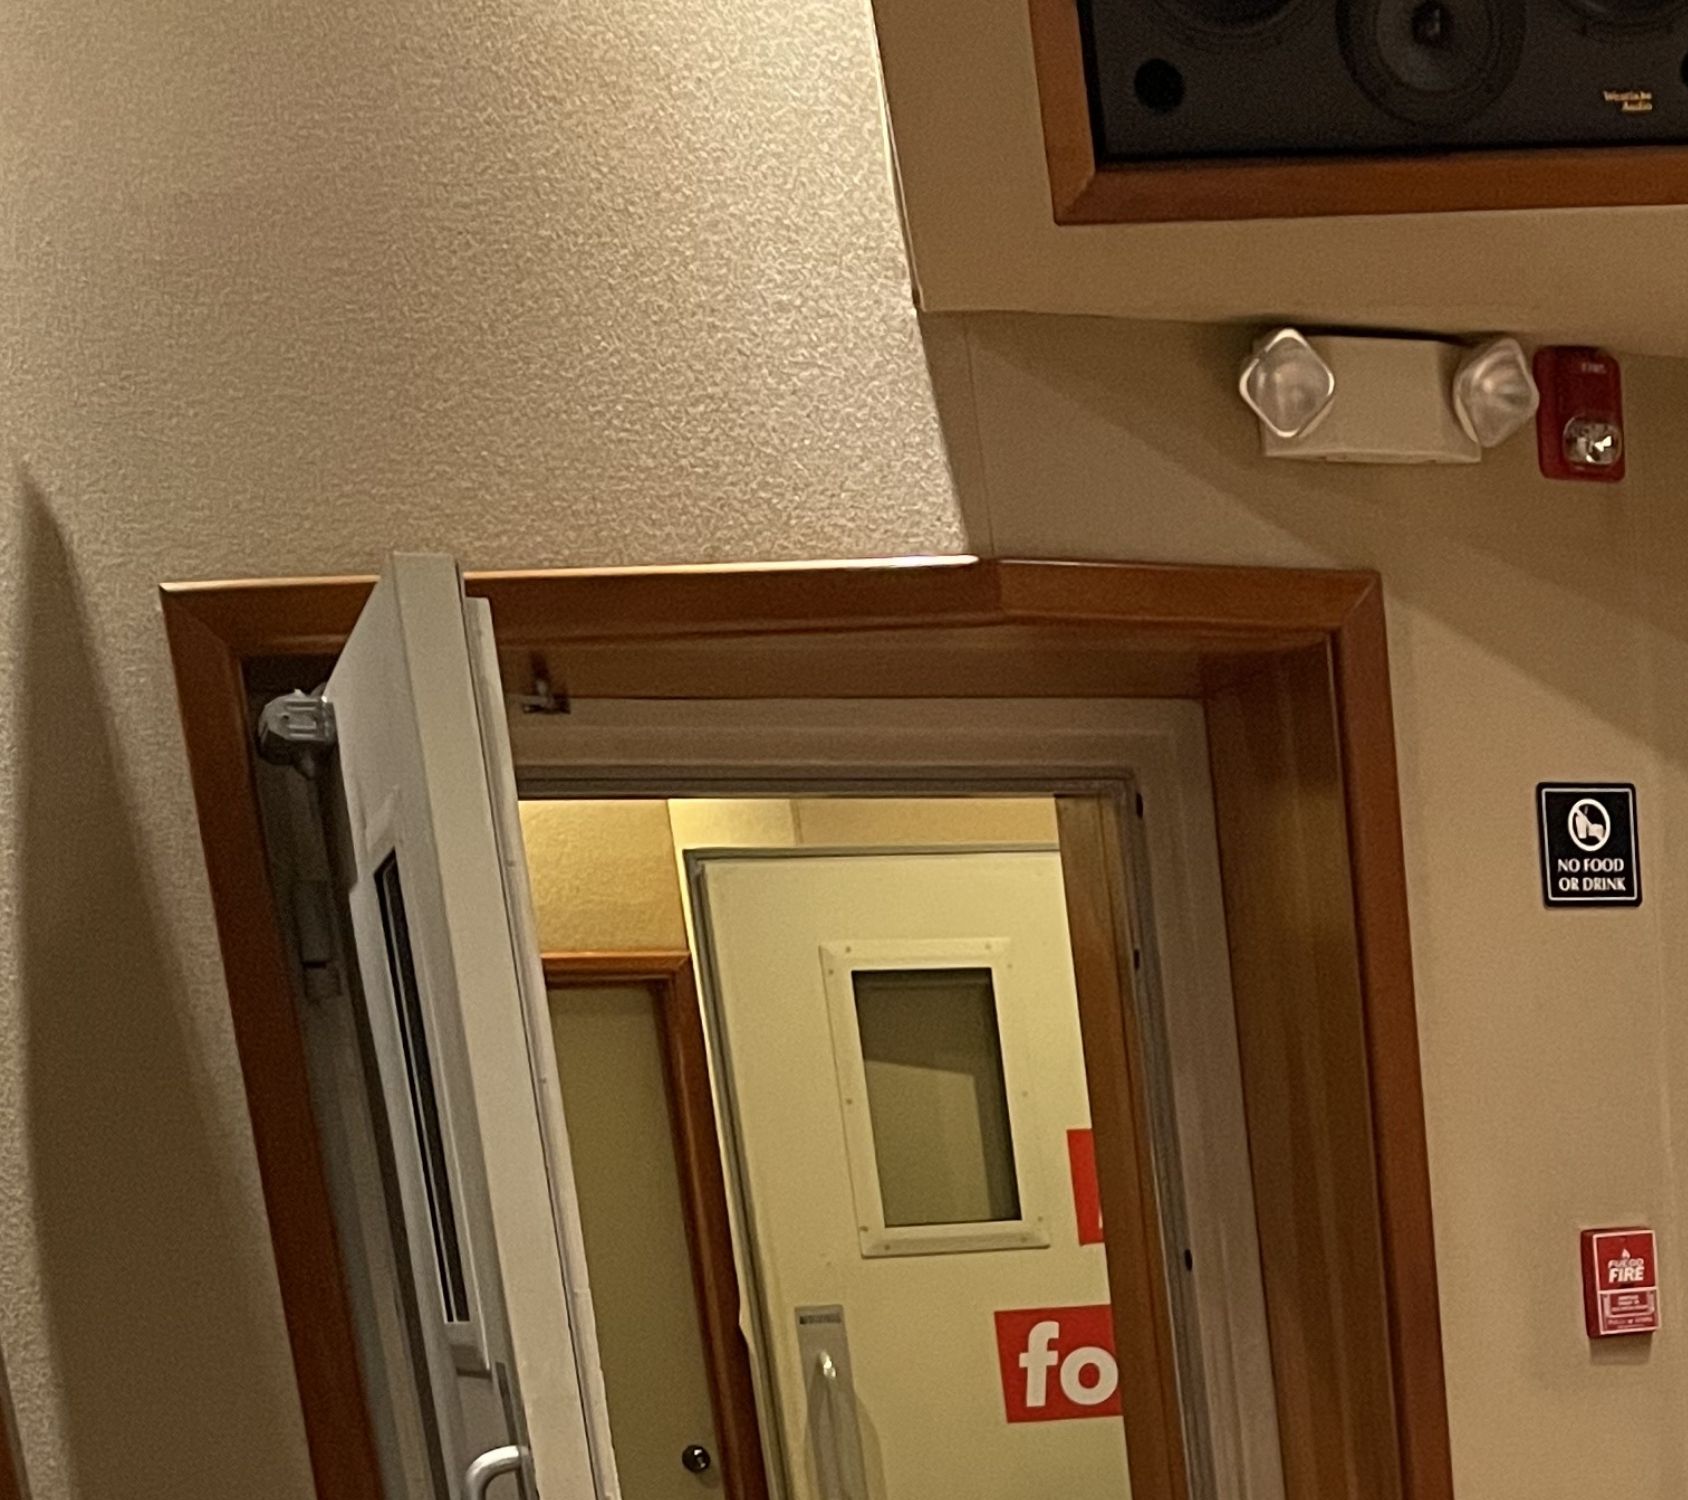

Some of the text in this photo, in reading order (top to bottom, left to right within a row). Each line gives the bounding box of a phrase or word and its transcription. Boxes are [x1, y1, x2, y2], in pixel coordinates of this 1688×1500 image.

[1558, 858, 1625, 872] NO FOOD
[1558, 877, 1626, 891] OR DRINK
[1609, 1267, 1645, 1283] FIRE
[1019, 1320, 1118, 1407] fo
